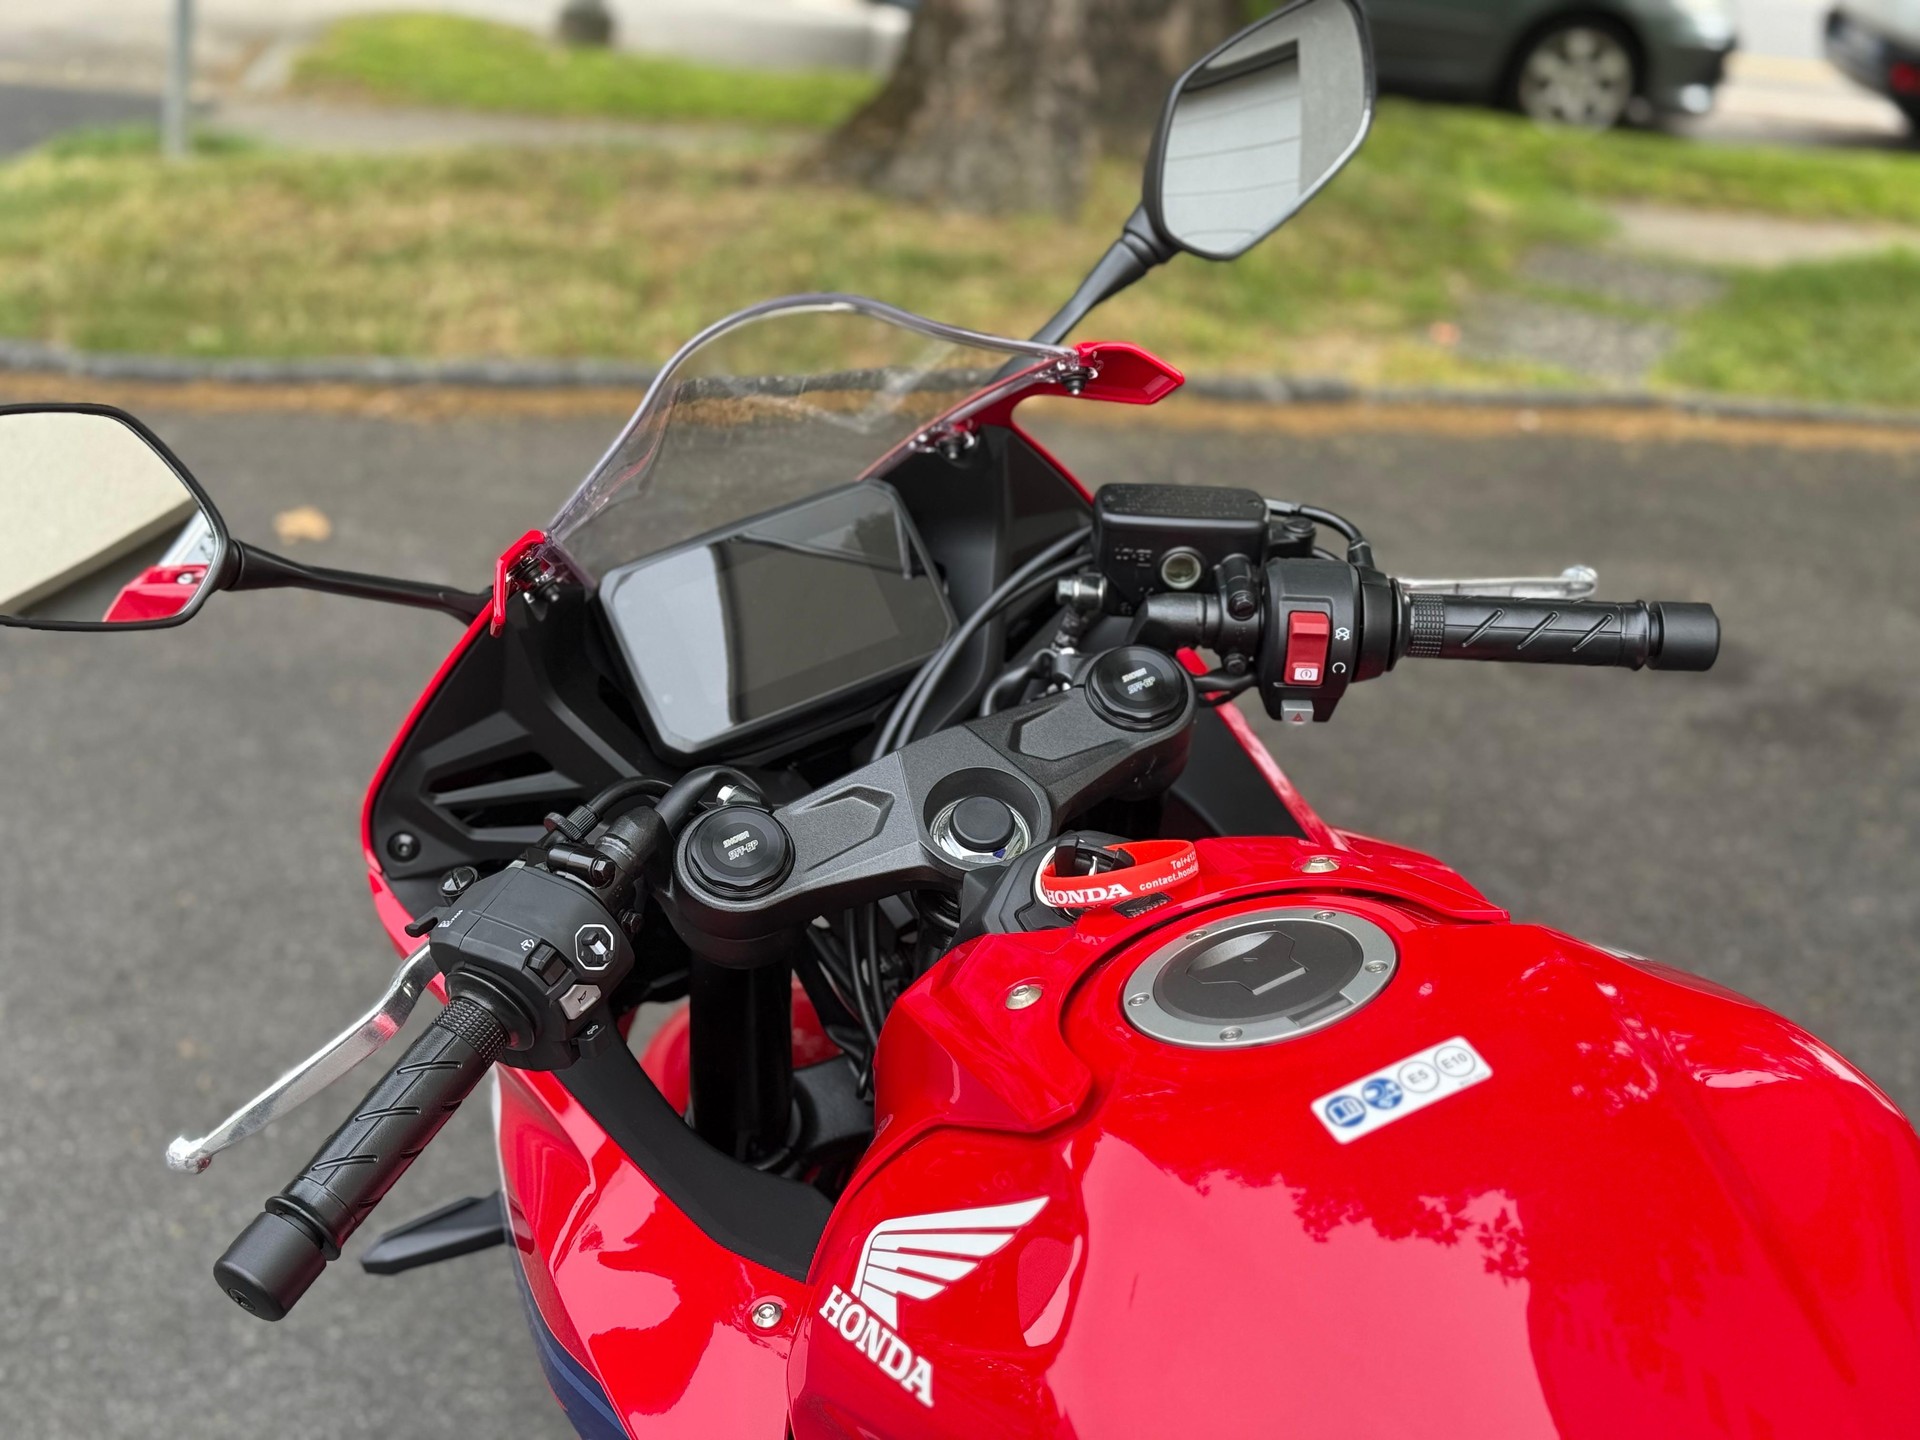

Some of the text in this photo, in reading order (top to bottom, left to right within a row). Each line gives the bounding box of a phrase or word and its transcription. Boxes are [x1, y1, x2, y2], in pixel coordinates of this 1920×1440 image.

[1045, 883, 1132, 905] HONDA
[1407, 1053, 1467, 1084] E5 E10
[818, 1284, 935, 1409] HONDA
